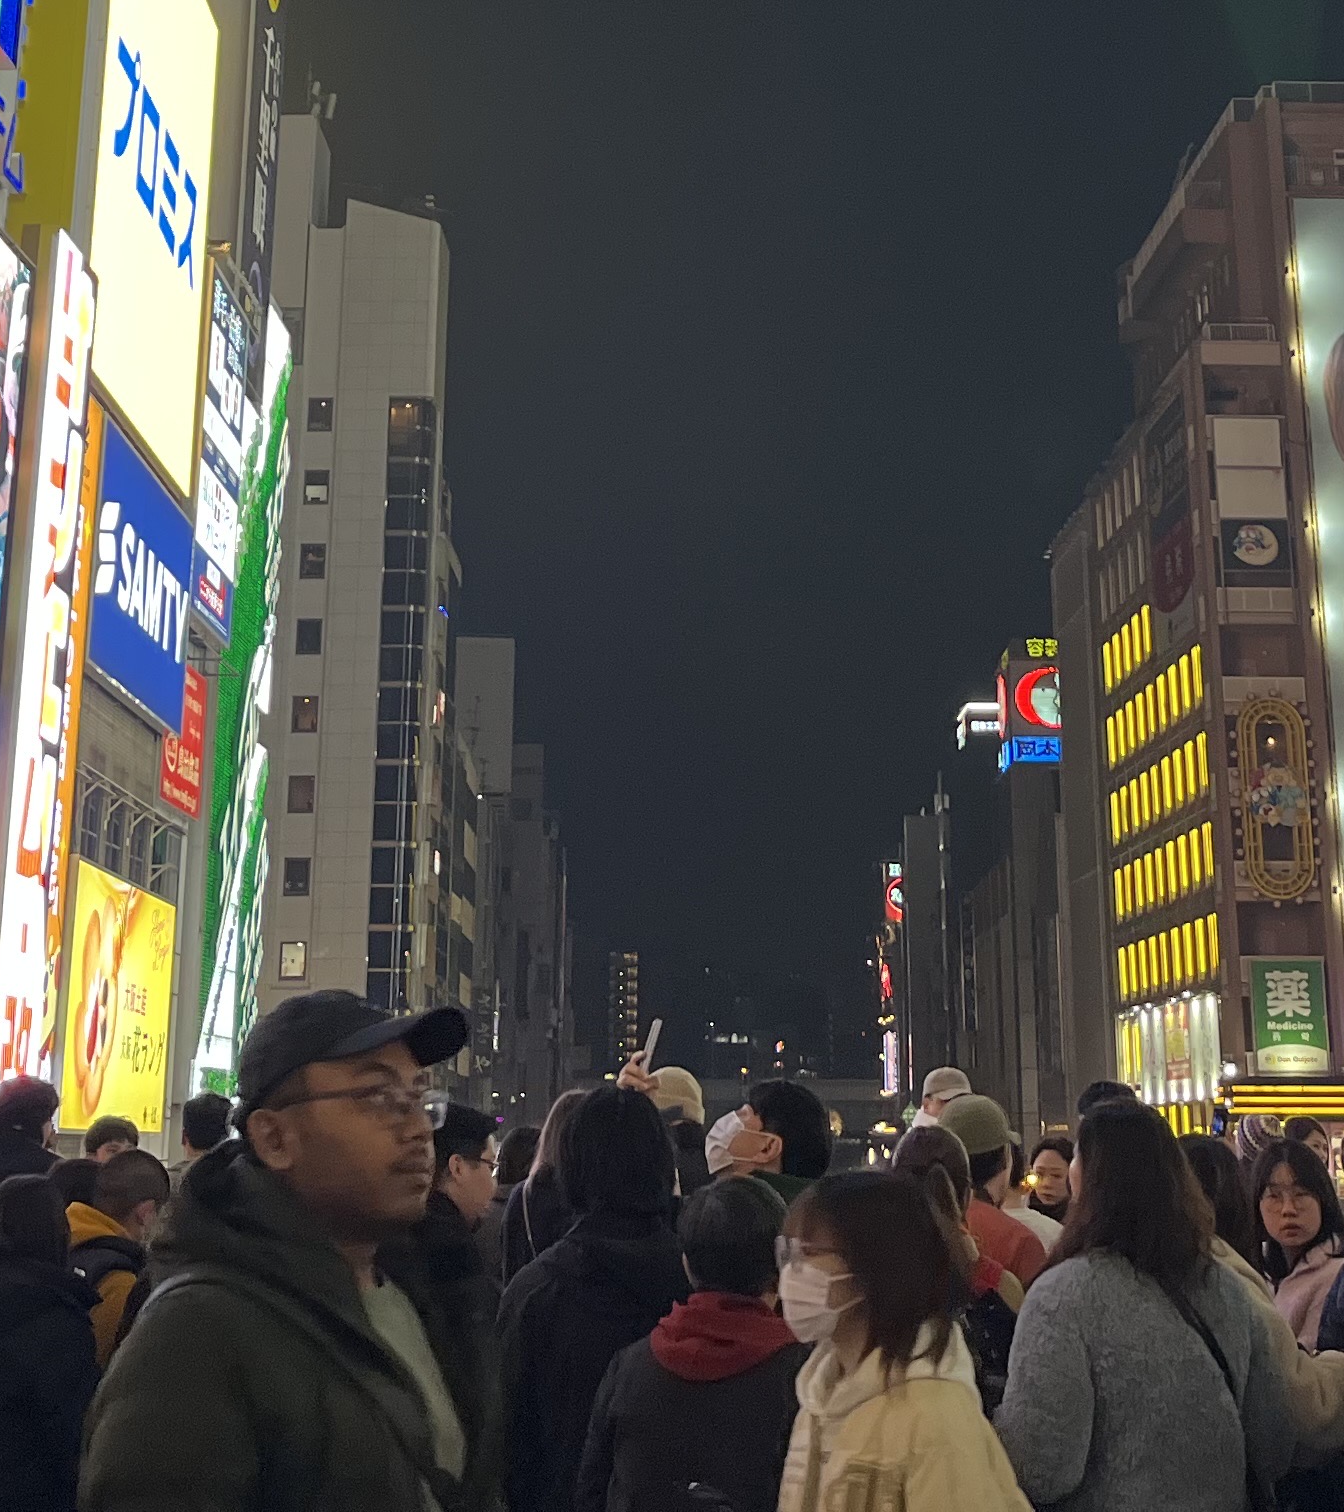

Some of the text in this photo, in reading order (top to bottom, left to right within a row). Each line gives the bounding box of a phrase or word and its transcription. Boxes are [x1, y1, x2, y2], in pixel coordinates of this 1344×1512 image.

[113, 35, 197, 289] プロミス
[117, 522, 189, 664] SAMTY
[1265, 970, 1311, 1017] 薬
[1266, 1021, 1314, 1031] Medicine
